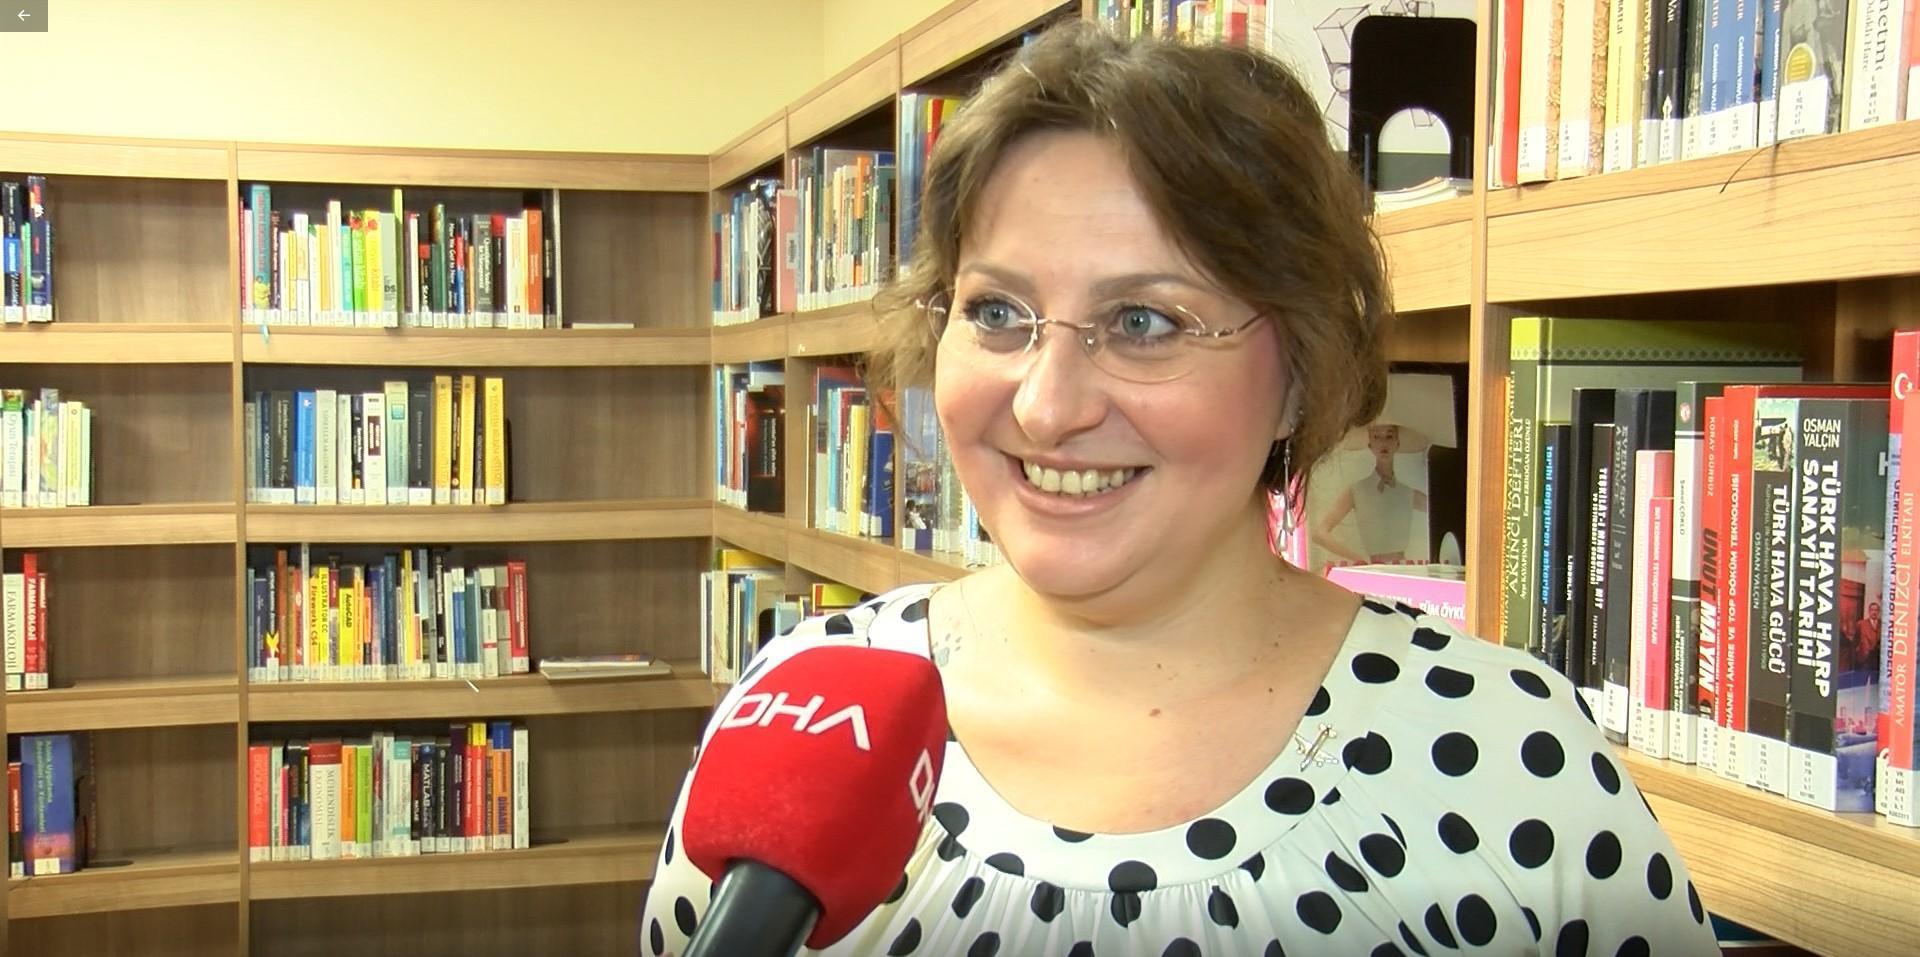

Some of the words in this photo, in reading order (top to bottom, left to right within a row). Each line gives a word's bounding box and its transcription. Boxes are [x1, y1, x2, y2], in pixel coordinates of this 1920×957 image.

[1803, 418, 1841, 434] OSMAN
[1803, 433, 1840, 451] YALÇIN
[1511, 417, 1523, 509] DEFTERİ
[1771, 484, 1789, 546] TÜRK
[1799, 459, 1820, 570] SANAYİİ
[1819, 460, 1842, 535] TÜRK
[1900, 492, 1914, 556] ELKİTABI
[1509, 515, 1520, 594] AKINCI
[1540, 550, 1550, 605] askerler
[1702, 527, 1718, 600] UNUT
[1769, 550, 1786, 607] HAVA
[1817, 541, 1836, 615] HAVA
[27, 577, 38, 641] FARMAKOLOJİ
[321, 573, 329, 622] ILLUSTRATOR
[345, 593, 353, 628] AutoCAD
[1728, 600, 1737, 621] TOP
[1752, 572, 1760, 609] YALÇIN
[1797, 575, 1816, 667] TARİHİ
[1895, 562, 1911, 656] DENİZCİ
[5, 591, 17, 669] FARMAKOLOJİ
[1698, 600, 1717, 693] MAYIN
[1728, 627, 1736, 640] VE
[1768, 611, 1787, 674] GÜCÜ
[1814, 622, 1833, 698] HARP
[719, 690, 872, 752] DHA
[1895, 663, 1907, 728] AMATÖR
[327, 770, 337, 839] MÜHENDİSLİK
[422, 763, 431, 807] MATLAB
